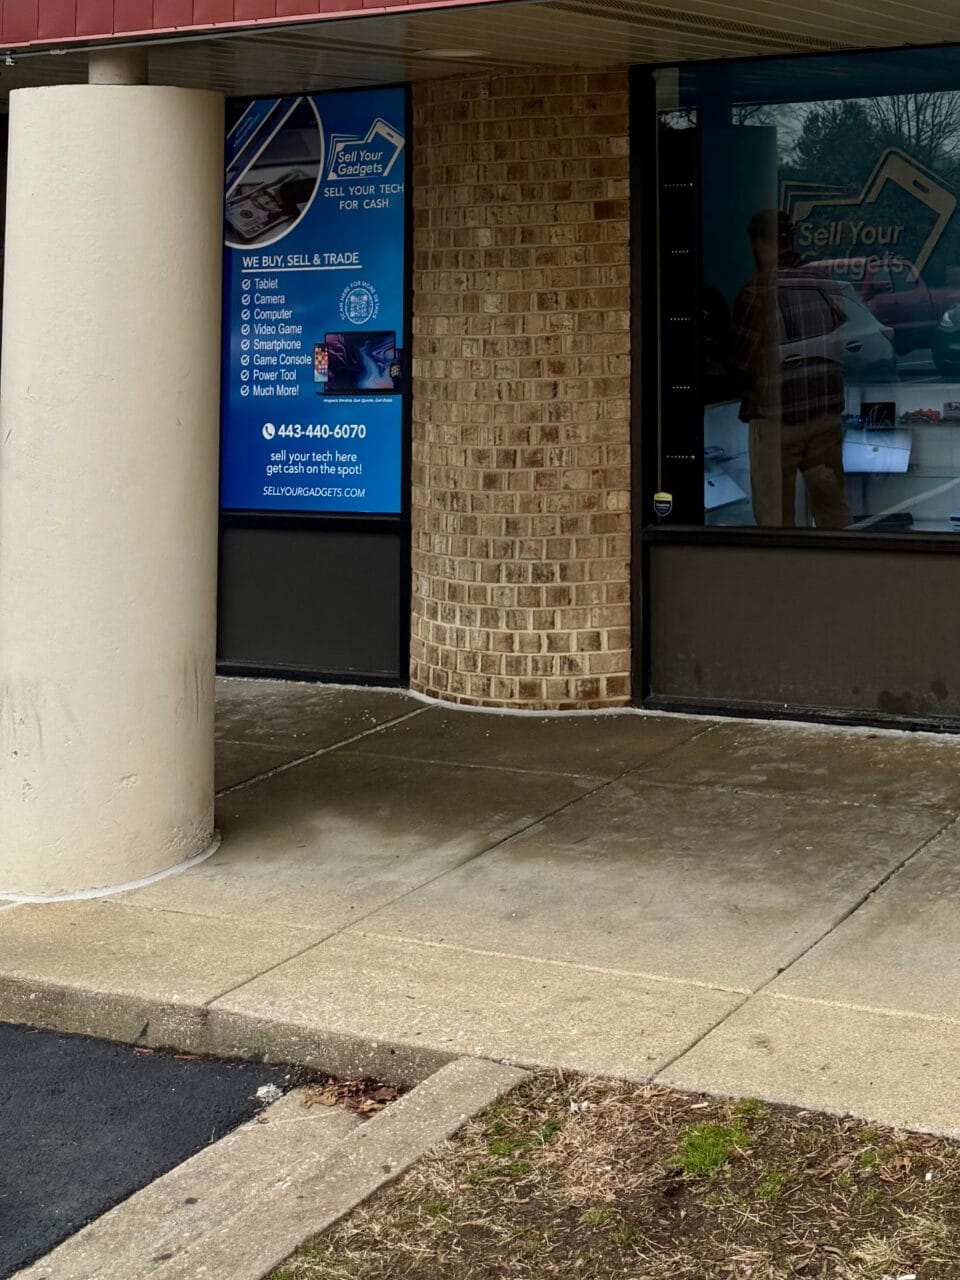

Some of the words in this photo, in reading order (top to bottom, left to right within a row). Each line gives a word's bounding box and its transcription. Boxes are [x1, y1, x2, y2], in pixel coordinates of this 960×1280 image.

[338, 150, 357, 163] Sell
[359, 149, 383, 161] Your
[337, 163, 383, 177] Gadgets
[324, 186, 345, 197] SELL
[348, 185, 375, 196] YOUR
[379, 183, 404, 195] TECH
[339, 200, 358, 210] FOR
[363, 198, 389, 209] CASH
[799, 221, 842, 246] Sell
[849, 220, 904, 245] Your
[242, 256, 259, 267] WE
[262, 255, 285, 267] BUY,
[287, 254, 311, 266] SELL
[313, 254, 321, 265] &
[323, 252, 359, 265] TRADE
[800, 250, 904, 280] Gdgets
[254, 278, 278, 289] Tablet
[254, 294, 285, 304] Camera
[254, 308, 293, 320] Computer
[254, 324, 276, 335] Video
[278, 323, 302, 334] Game
[253, 339, 301, 351] Smartphone
[253, 354, 277, 365] Game
[279, 354, 312, 365] Console
[253, 369, 278, 380] Power
[280, 369, 296, 380] Tool
[252, 384, 274, 396] Much
[276, 384, 299, 396] More!
[277, 424, 366, 439] 443-440-6070
[270, 450, 286, 461] sell
[289, 452, 310, 463] your
[312, 450, 333, 461] tech
[335, 451, 357, 462] here
[266, 464, 283, 476] get
[283, 462, 305, 474] cash
[306, 466, 319, 474] on
[320, 463, 336, 474] the
[337, 464, 363, 478] spot!
[263, 486, 365, 498] SELLYOURGADGETS.COM
